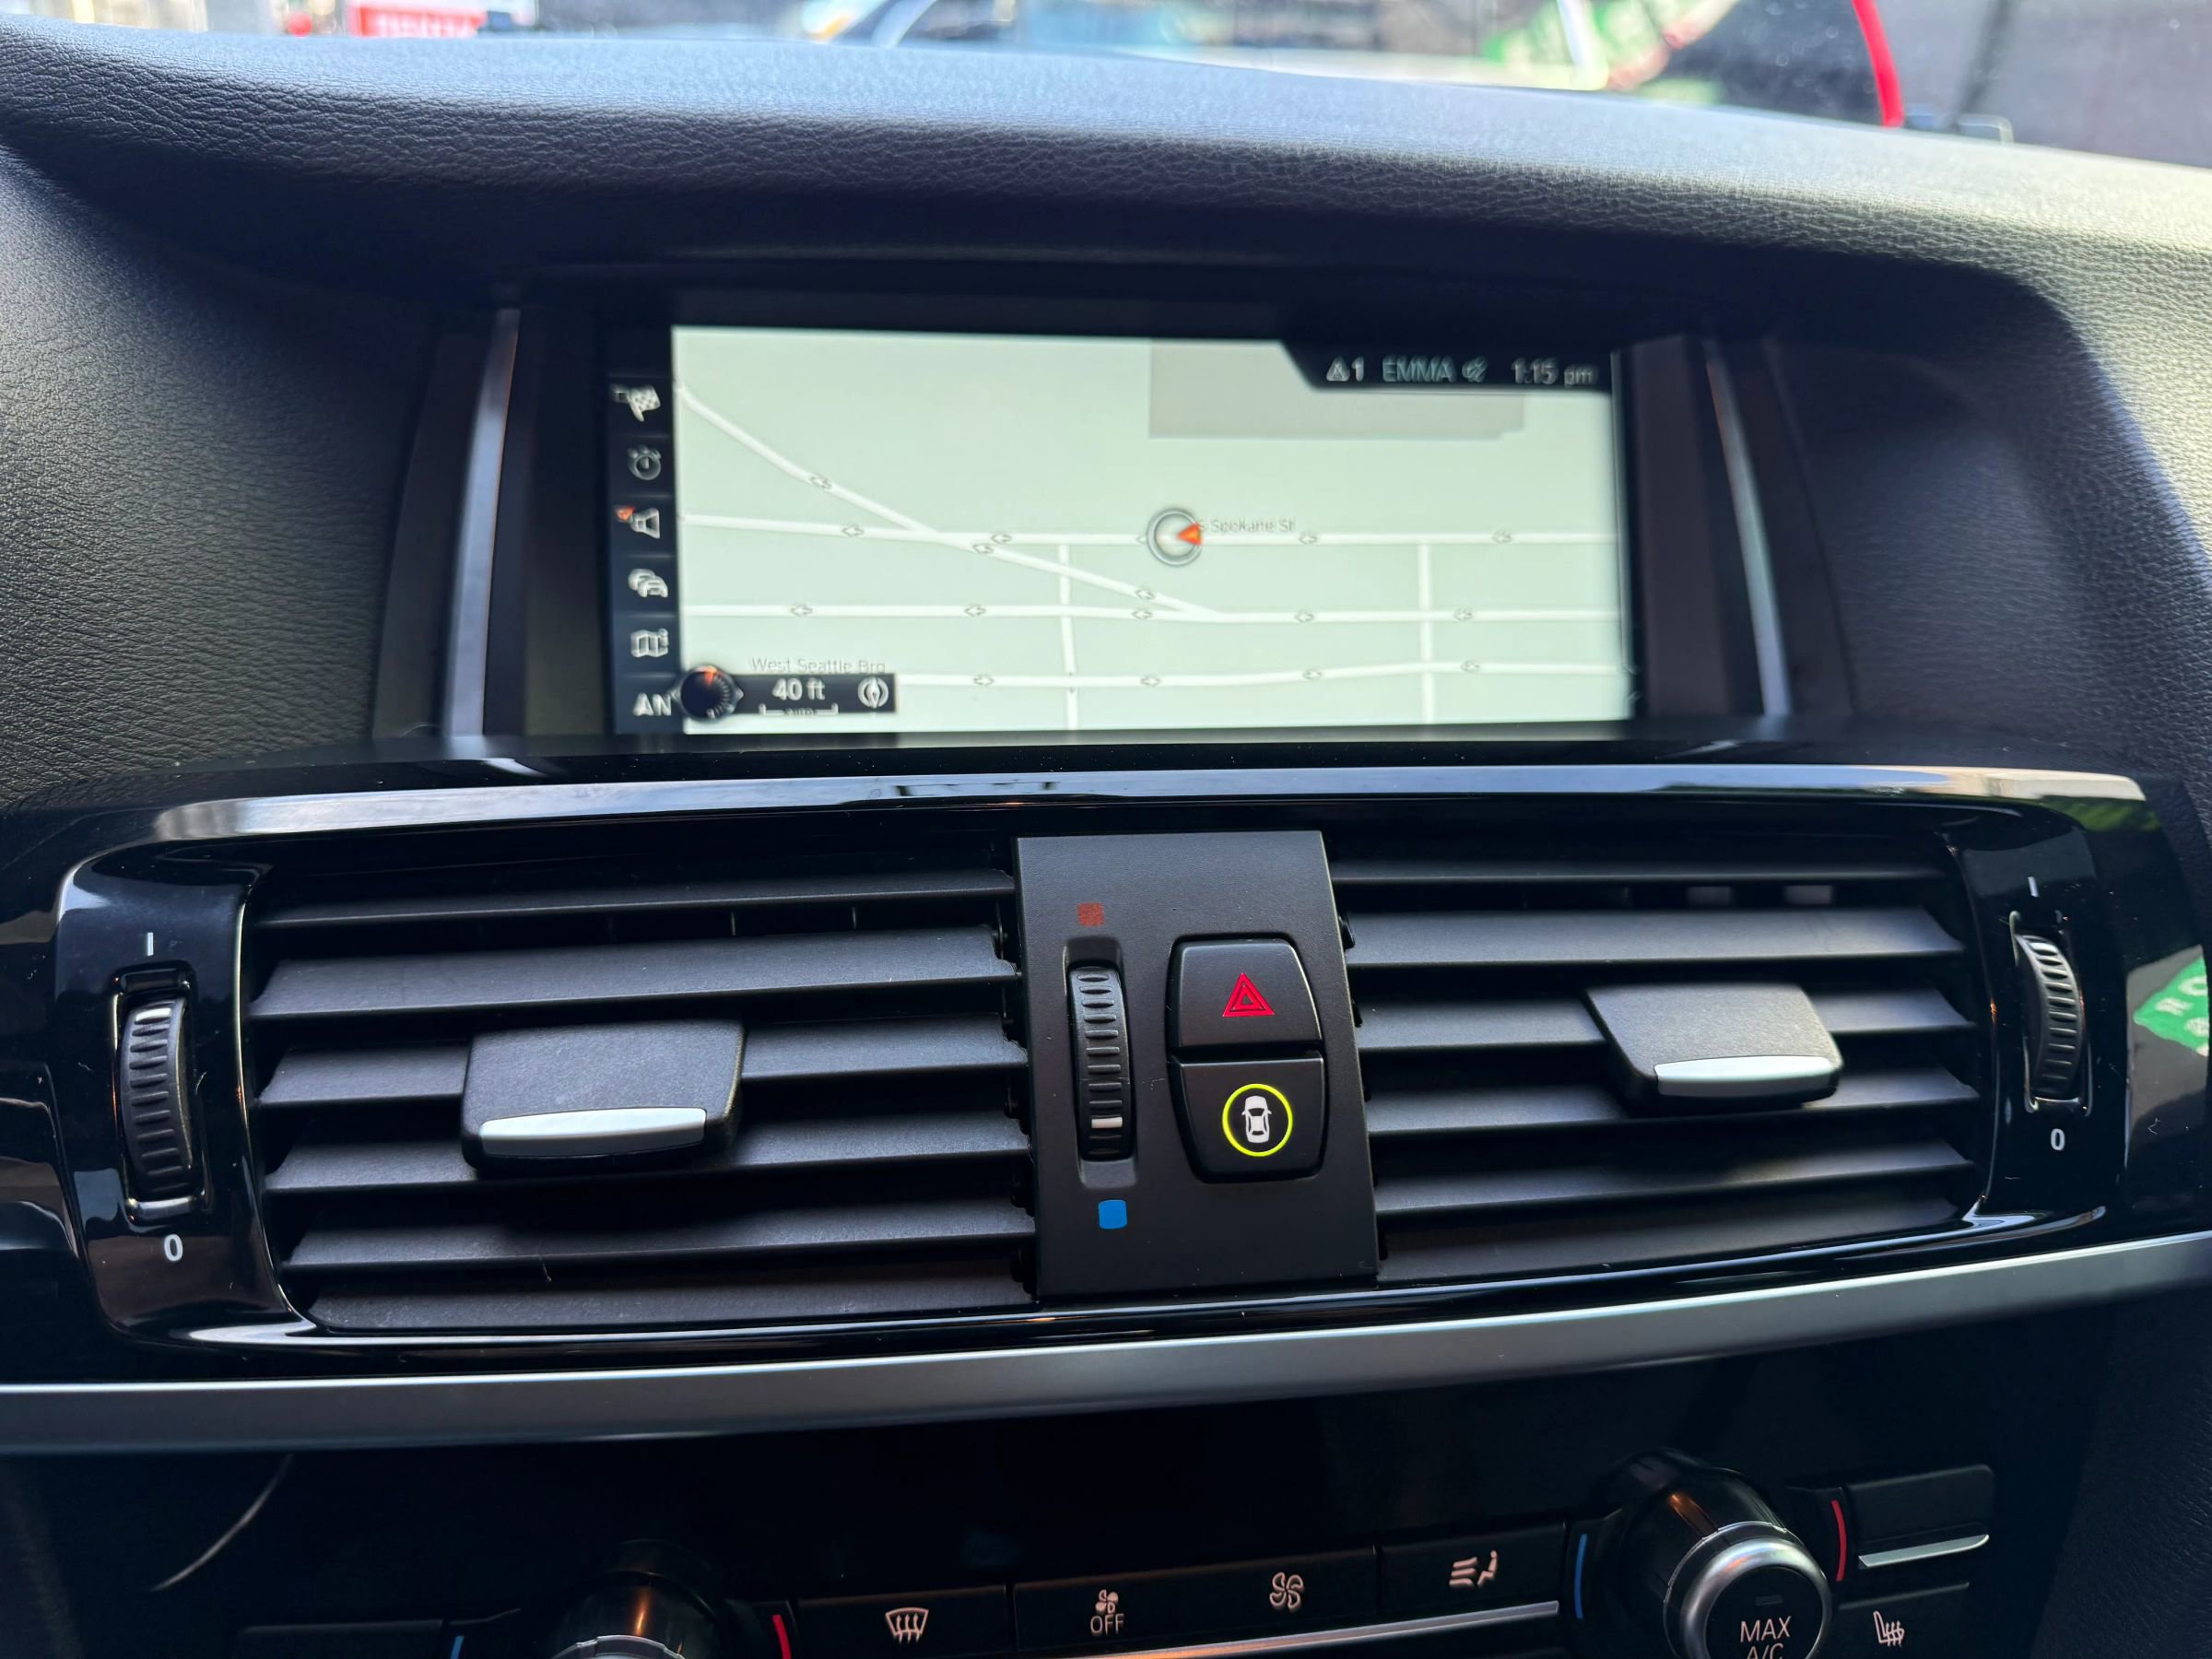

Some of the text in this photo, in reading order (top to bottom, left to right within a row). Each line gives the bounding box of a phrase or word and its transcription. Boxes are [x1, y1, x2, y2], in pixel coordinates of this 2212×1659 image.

[1351, 356, 1599, 388] 1 EMMA 1:15 pm
[752, 657, 792, 673] West
[797, 657, 853, 674] Seattle
[771, 677, 826, 701] 40 ft
[1089, 1613, 1124, 1635] OFF
[1739, 1615, 1792, 1643] MAX
[1746, 1642, 1784, 1659] A/C
